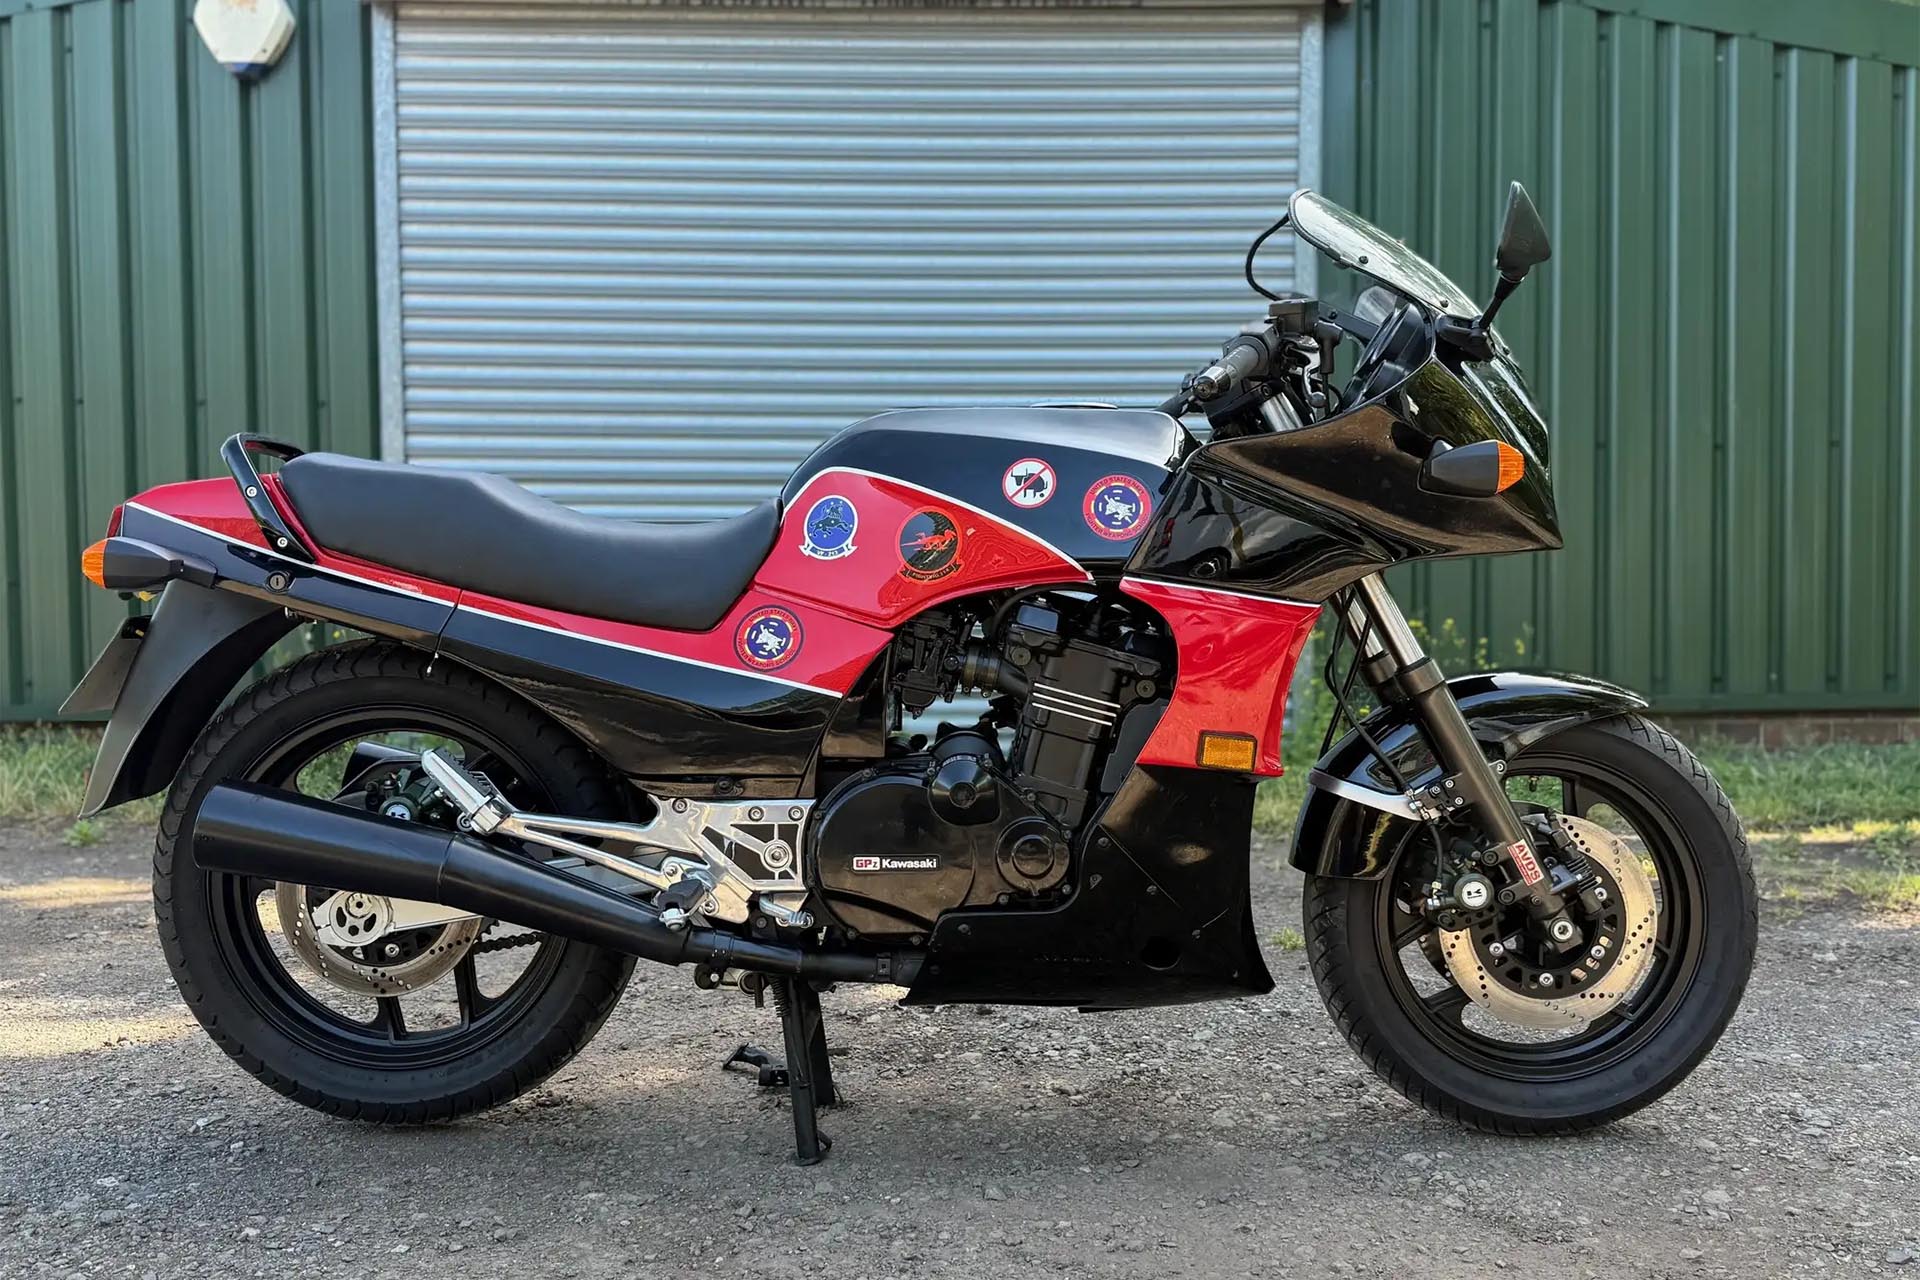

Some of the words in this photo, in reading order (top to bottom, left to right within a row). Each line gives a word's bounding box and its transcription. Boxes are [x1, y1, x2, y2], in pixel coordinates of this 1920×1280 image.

[1090, 479, 1109, 495] UNITED
[1109, 476, 1131, 484] STATES
[881, 858, 937, 869] Kawasaki
[1515, 843, 1542, 881] AVDS
